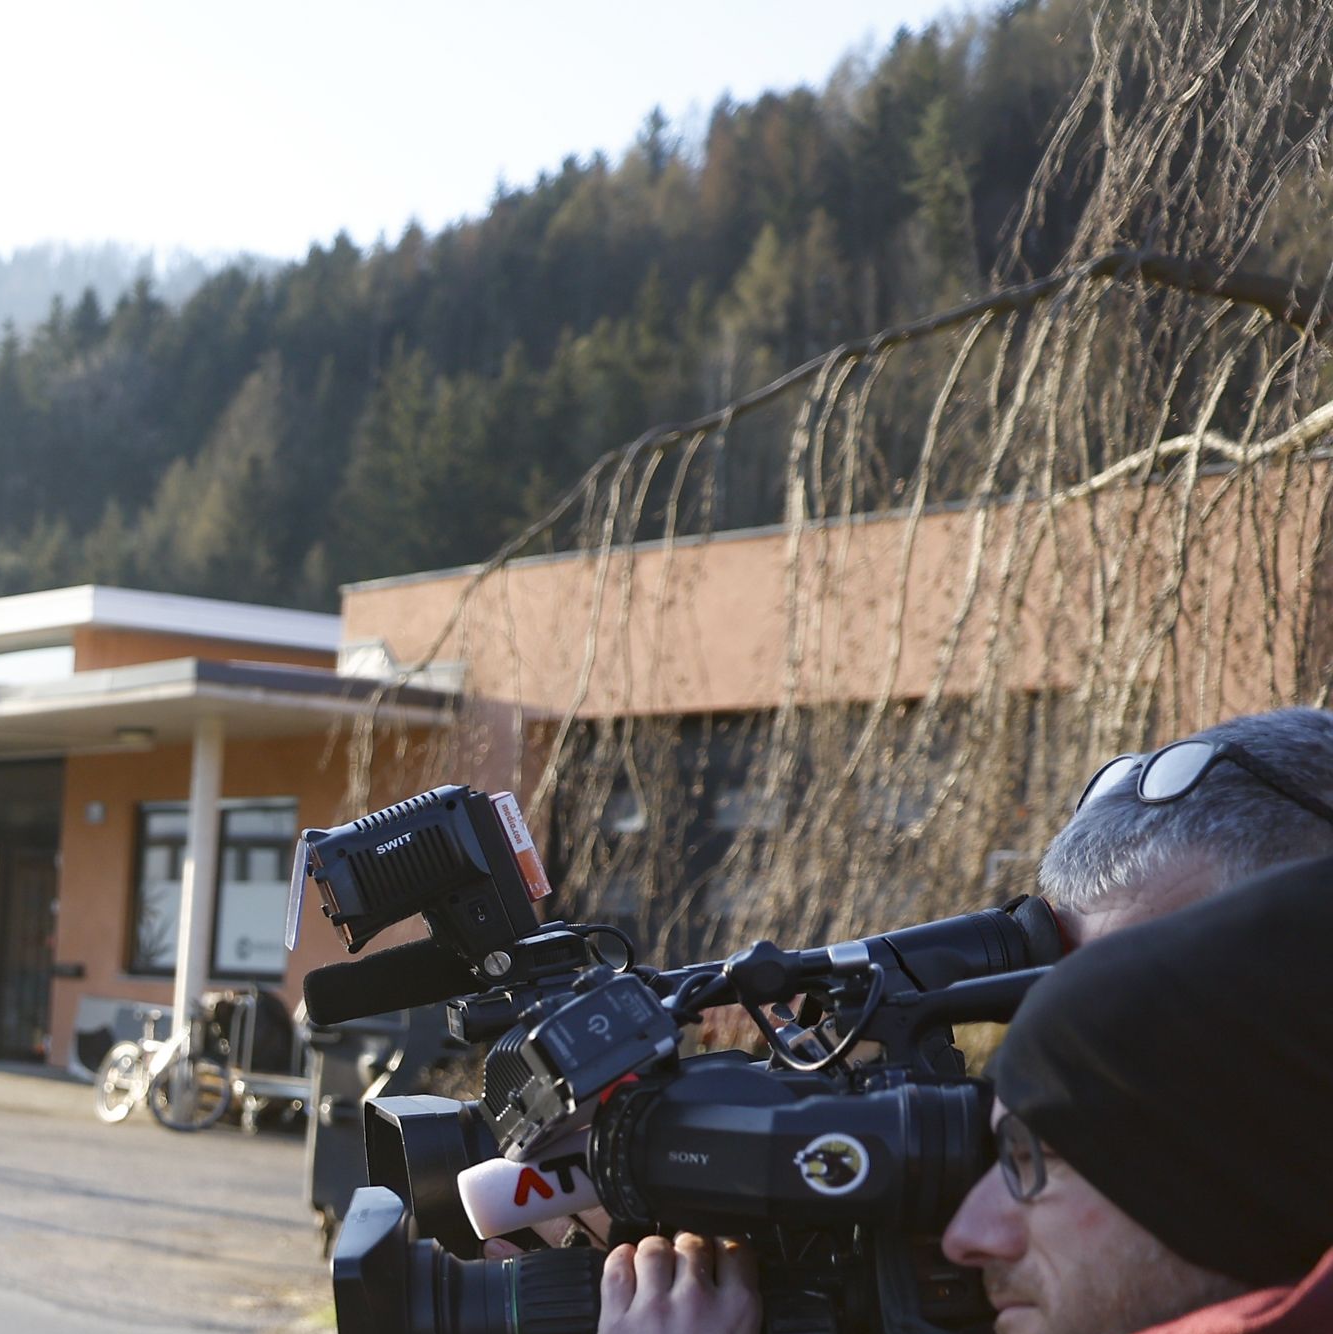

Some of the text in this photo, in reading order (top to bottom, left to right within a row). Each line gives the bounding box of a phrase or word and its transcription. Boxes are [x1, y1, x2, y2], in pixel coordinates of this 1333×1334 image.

[376, 832, 412, 855] SWIT
[668, 1151, 709, 1165] SONY
[514, 1152, 591, 1206] AT
